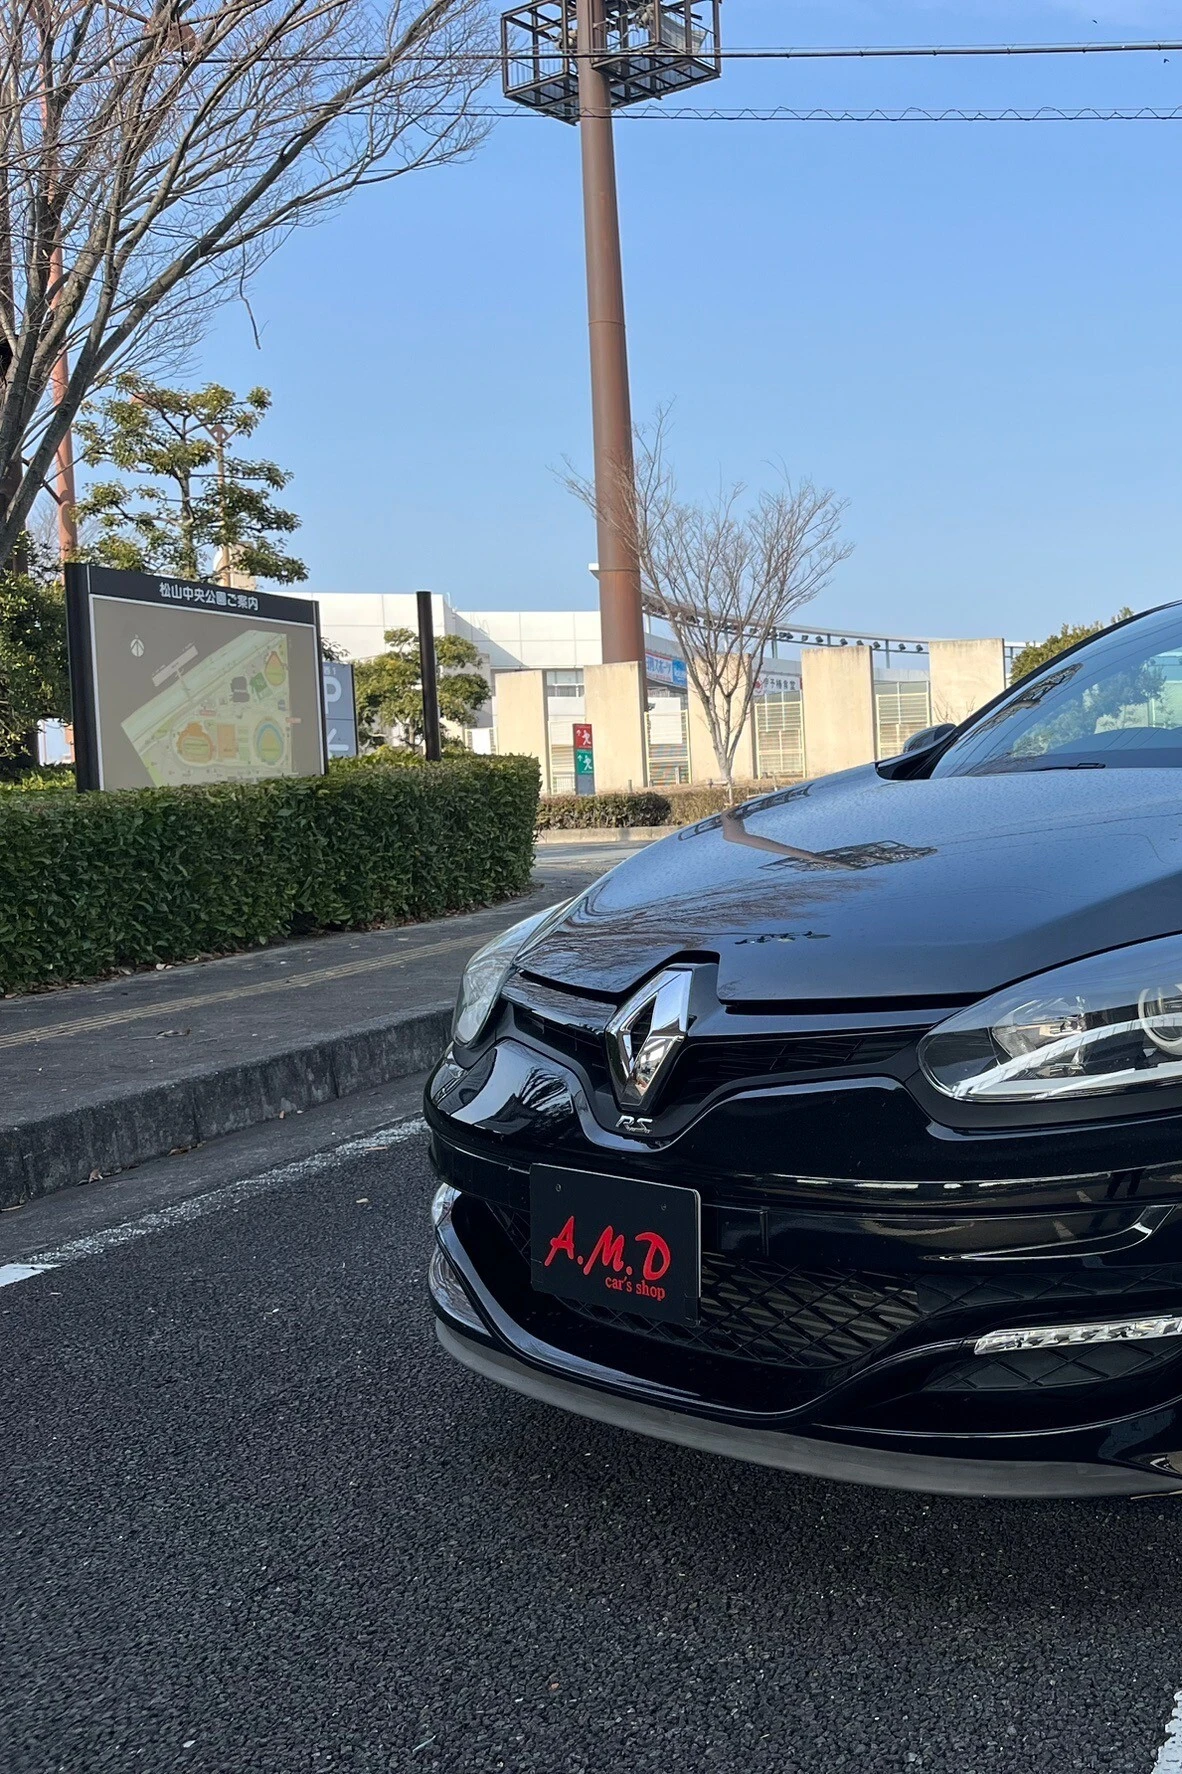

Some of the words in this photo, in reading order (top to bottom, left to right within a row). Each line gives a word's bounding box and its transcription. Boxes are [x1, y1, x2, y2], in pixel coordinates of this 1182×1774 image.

[159, 581, 259, 611] 松山中央公園ご案内
[615, 1115, 653, 1133] RS
[544, 1215, 671, 1281] A.M.D
[605, 1276, 633, 1293] car's
[636, 1279, 666, 1302] shop
